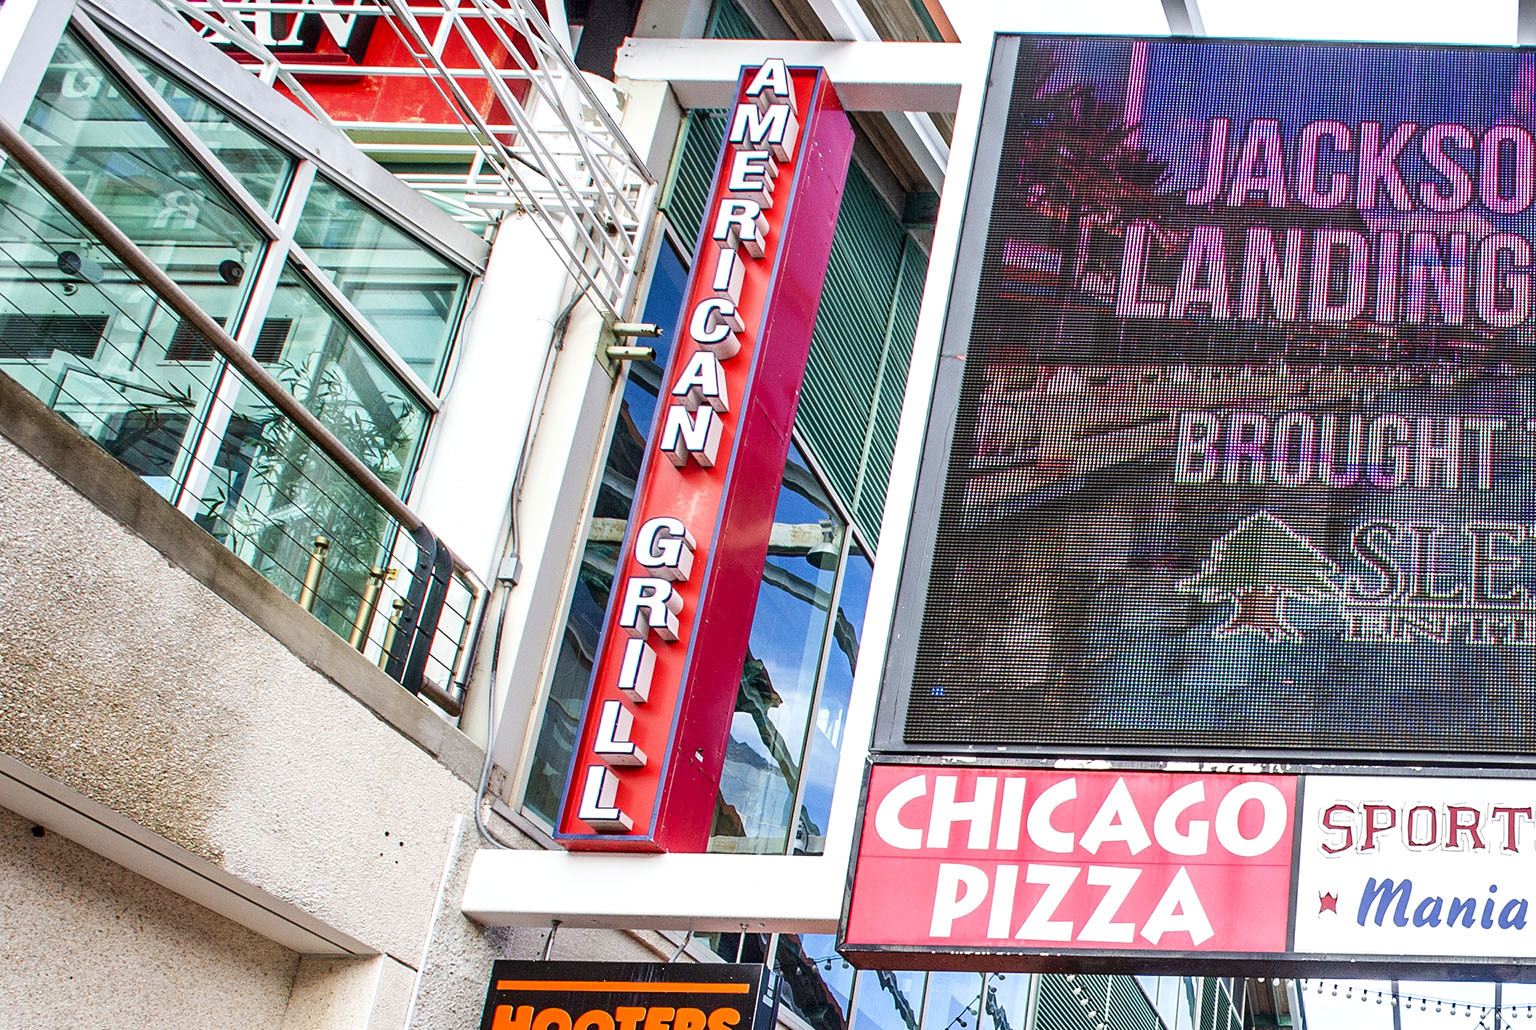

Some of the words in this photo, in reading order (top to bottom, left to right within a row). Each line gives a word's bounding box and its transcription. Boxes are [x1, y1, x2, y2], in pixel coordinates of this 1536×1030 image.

[658, 56, 800, 466] AMERICAN
[1115, 223, 1530, 328] LANDING
[1174, 410, 1507, 489] BROUGHT
[579, 515, 694, 831] GRILL
[874, 774, 1288, 858] CHICAGO
[929, 863, 1215, 947] PIZZA
[1356, 877, 1528, 931] Mania
